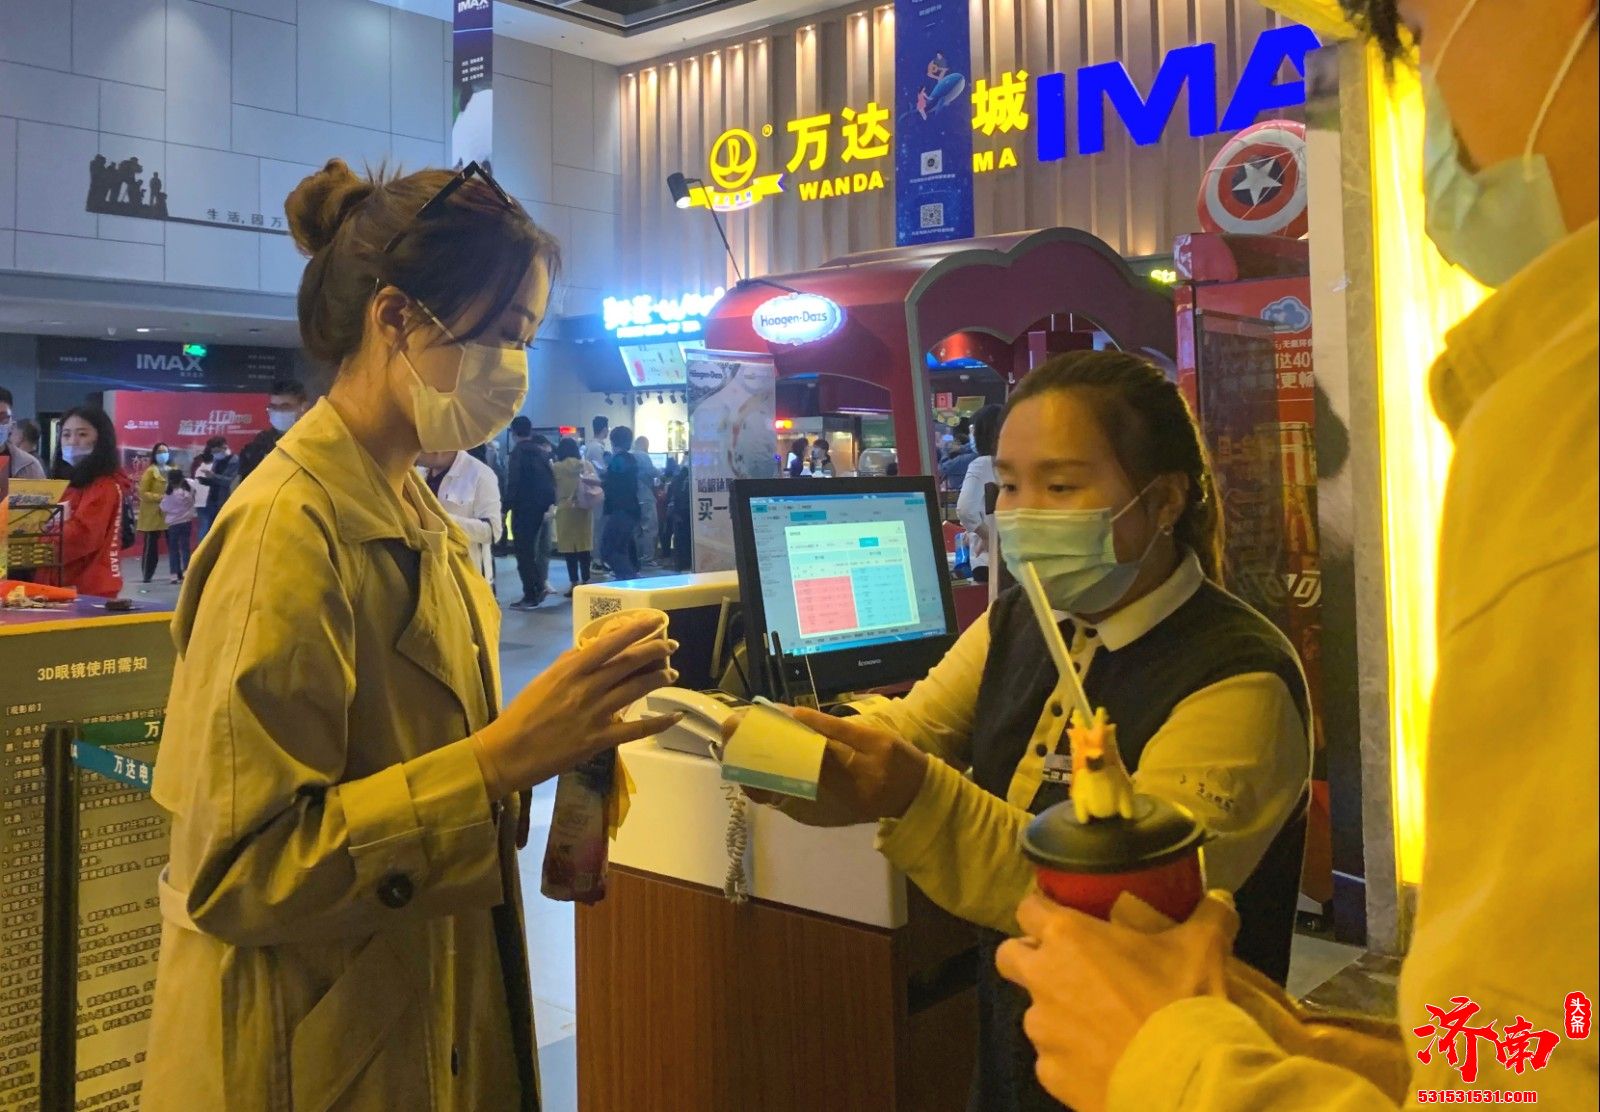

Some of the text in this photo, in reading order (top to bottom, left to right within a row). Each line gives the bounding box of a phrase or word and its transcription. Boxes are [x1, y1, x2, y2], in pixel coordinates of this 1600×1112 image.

[786, 70, 1029, 173] 万达 城
[799, 170, 884, 201] WANDA
[136, 353, 203, 372] IMAX
[110, 551, 121, 577] LOVE
[144, 721, 160, 739] 万
[114, 754, 149, 781] 万达电
